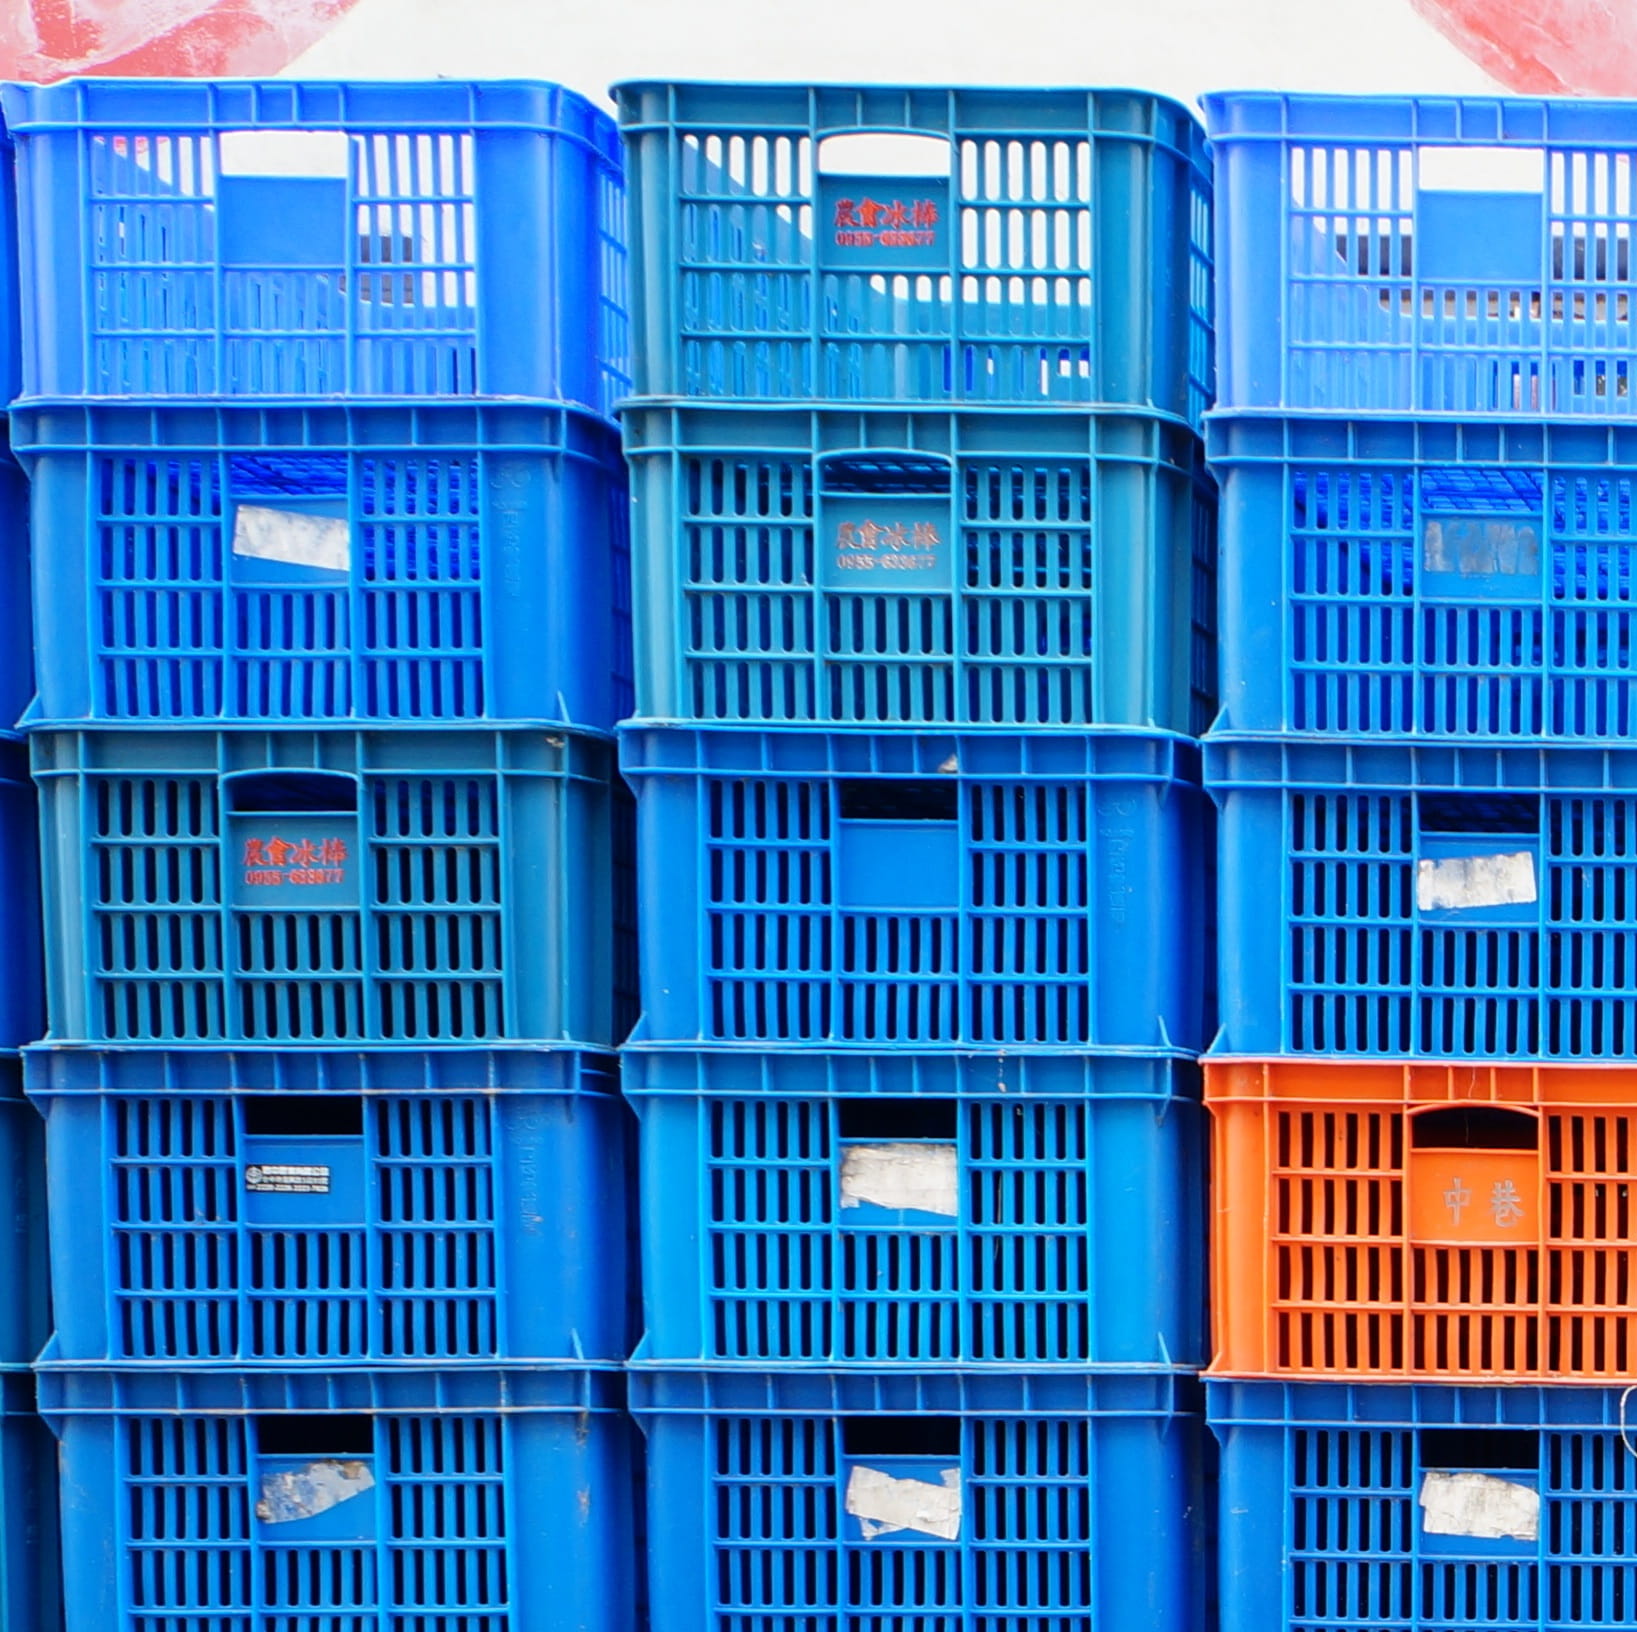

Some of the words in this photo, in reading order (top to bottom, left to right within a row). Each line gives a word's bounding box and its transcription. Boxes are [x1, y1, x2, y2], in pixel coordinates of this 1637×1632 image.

[835, 198, 938, 228] 農會冰棒
[837, 520, 941, 552] 農會冰棒
[244, 836, 347, 867] 農會冰棒
